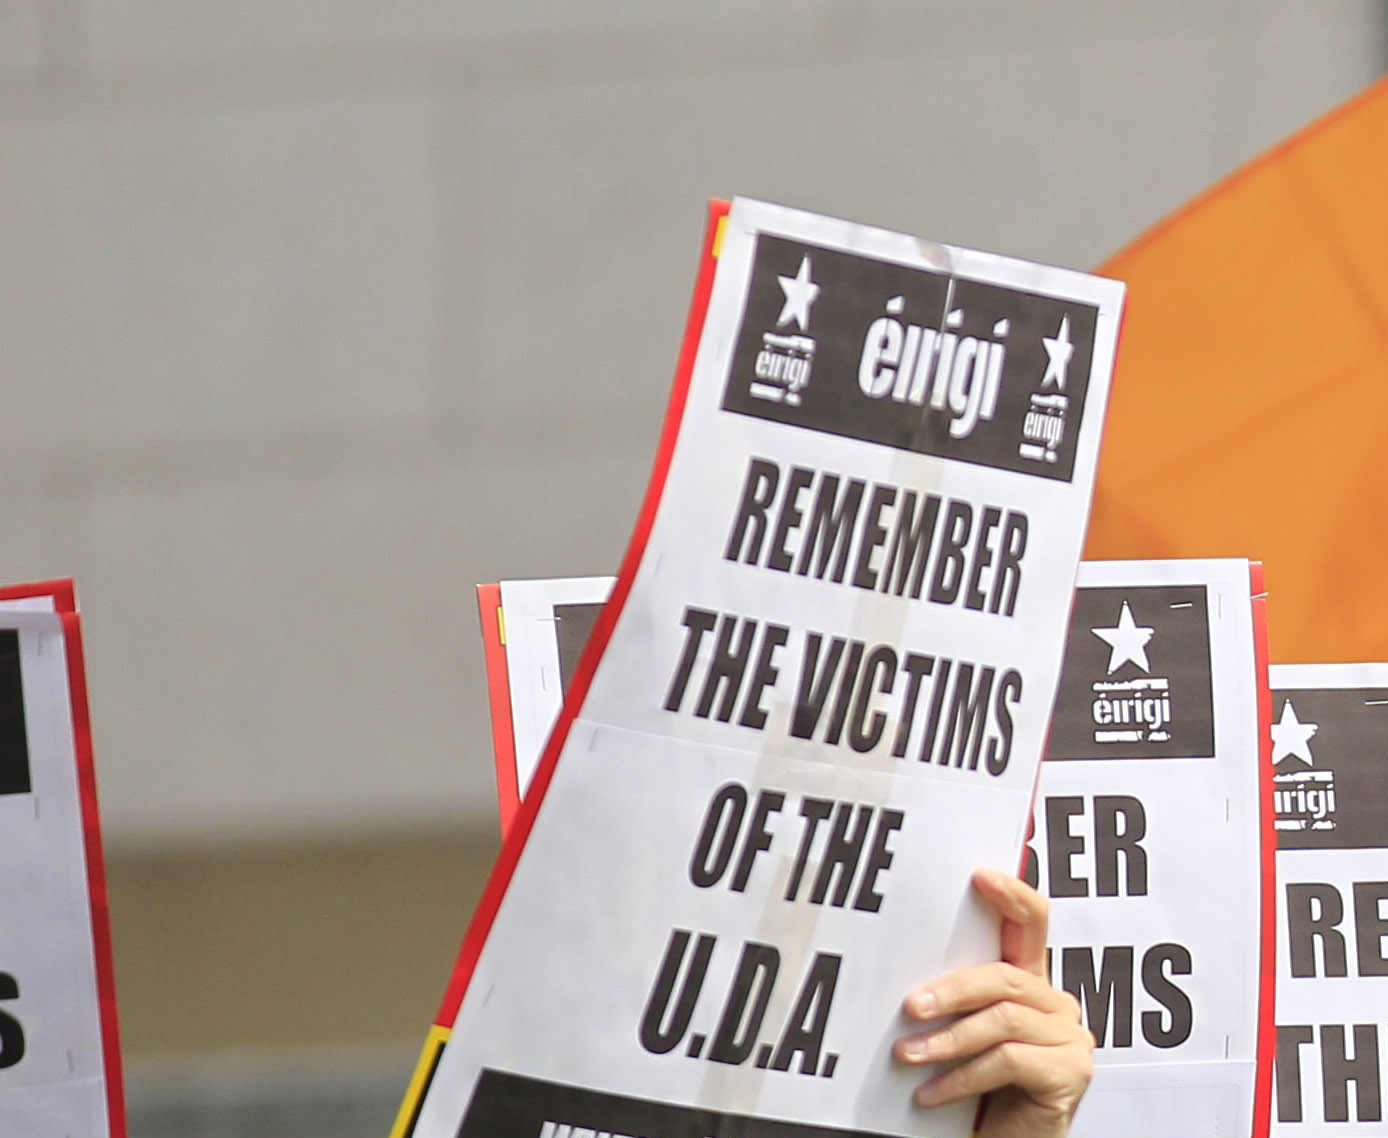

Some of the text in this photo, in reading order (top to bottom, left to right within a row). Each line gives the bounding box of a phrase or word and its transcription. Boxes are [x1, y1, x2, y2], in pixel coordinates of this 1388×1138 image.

[724, 456, 1029, 617] REMEMBER
[662, 605, 1023, 777] THE VICTIMS
[689, 780, 905, 915] OF THE
[638, 929, 843, 1080] U.D.A.
